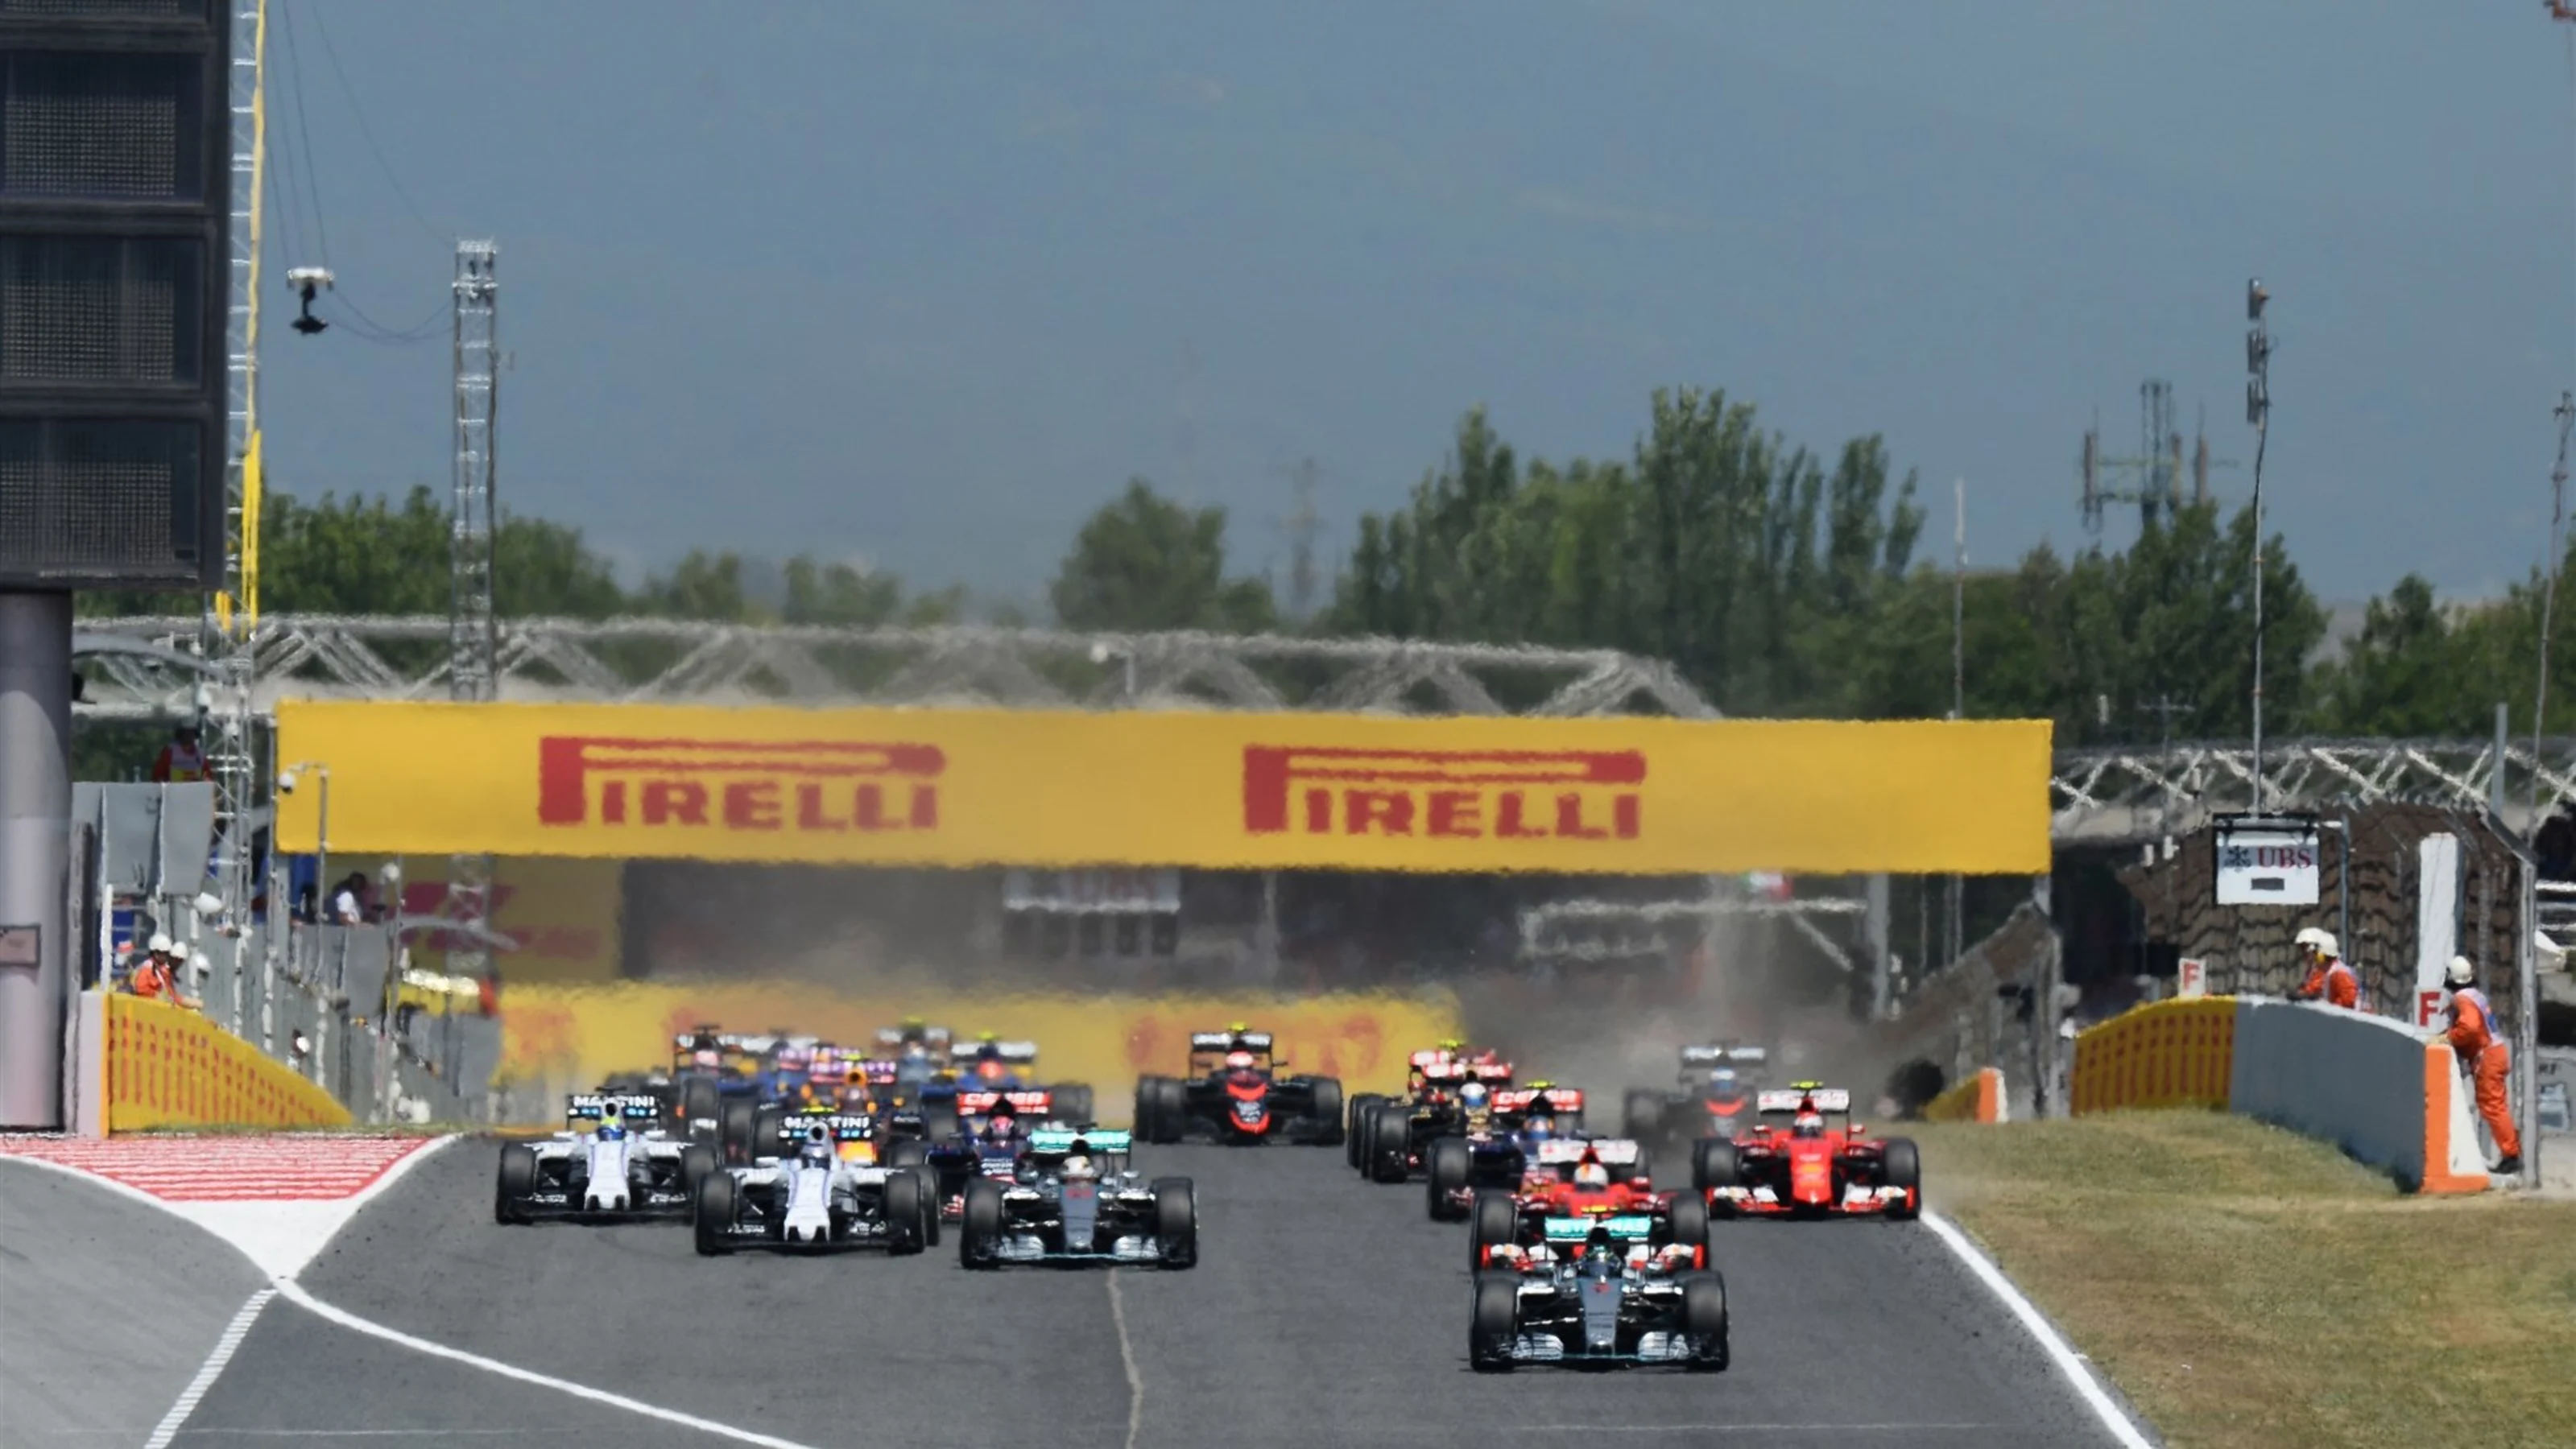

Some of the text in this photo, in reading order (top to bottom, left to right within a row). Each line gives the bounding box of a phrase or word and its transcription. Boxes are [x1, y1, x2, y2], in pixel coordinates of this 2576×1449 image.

[538, 737, 946, 830] PIRELLI
[1243, 745, 1646, 839] PIRELLI
[2257, 846, 2312, 869] UBS
[2183, 963, 2201, 991] F
[2419, 991, 2441, 1028] F
[573, 1096, 655, 1108] MATINI
[784, 1116, 870, 1129] MATINI
